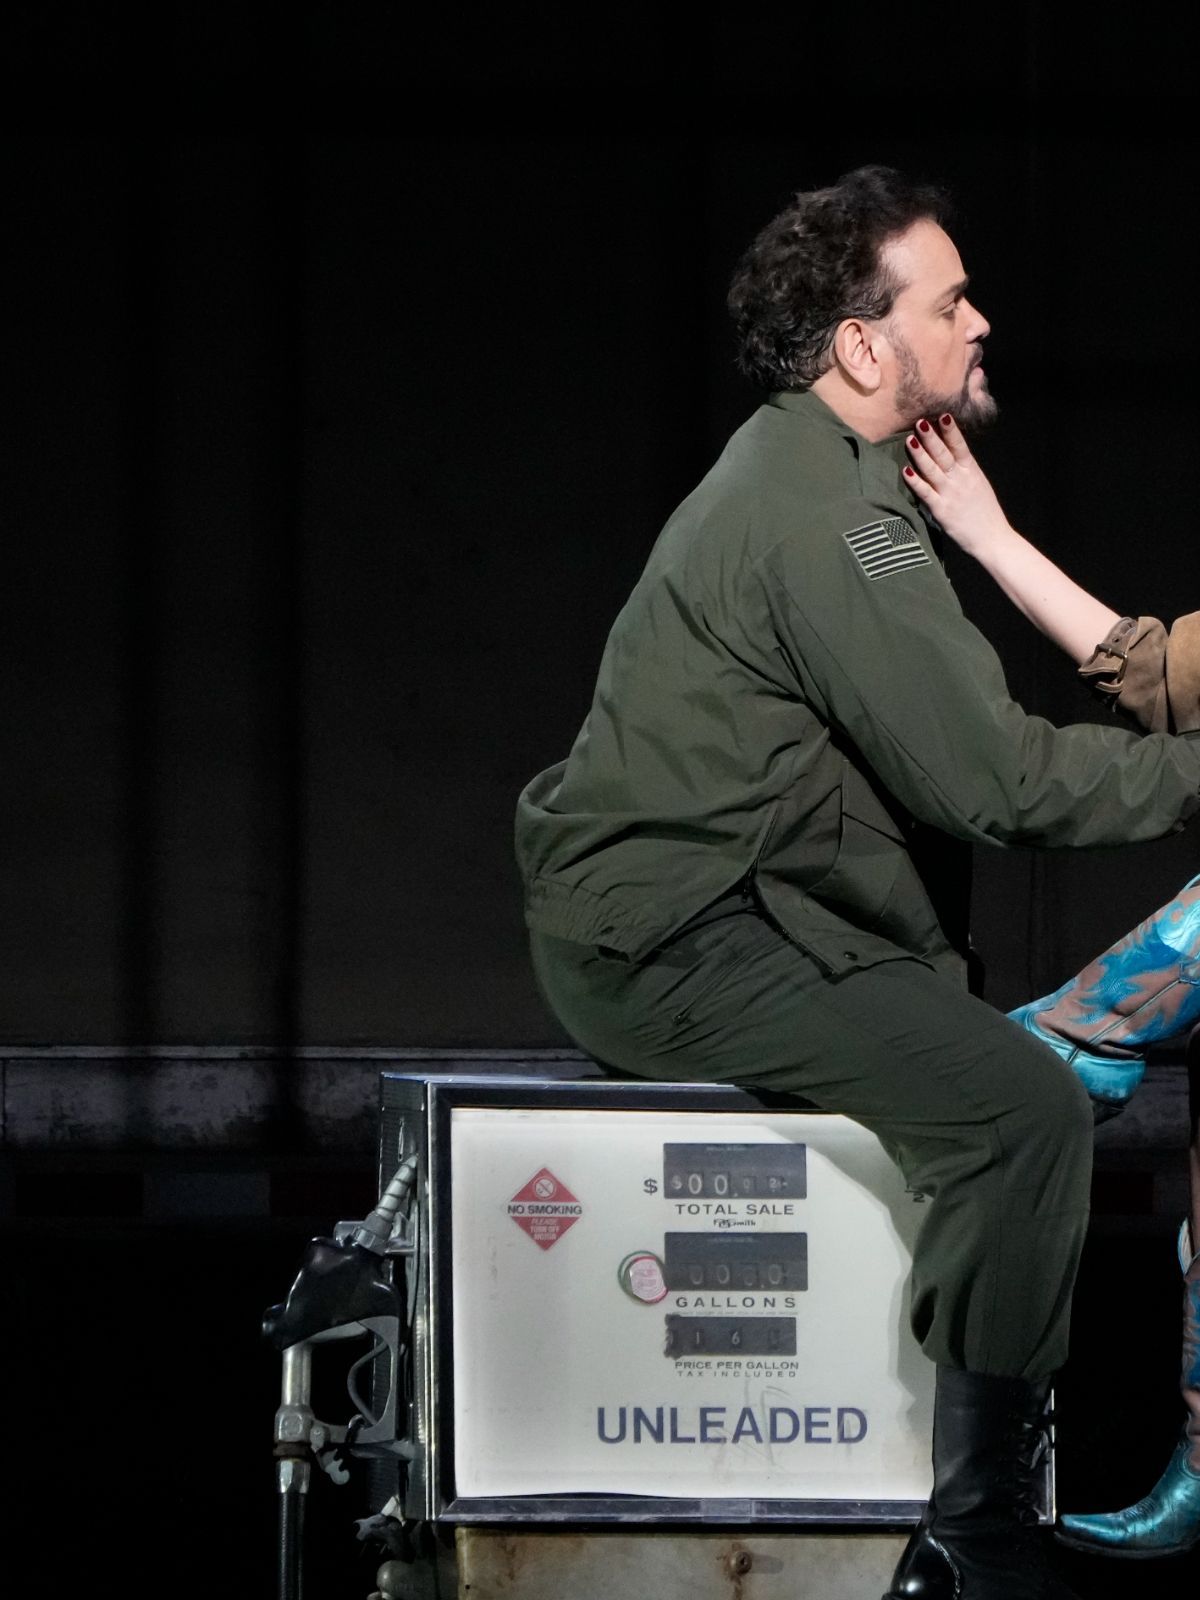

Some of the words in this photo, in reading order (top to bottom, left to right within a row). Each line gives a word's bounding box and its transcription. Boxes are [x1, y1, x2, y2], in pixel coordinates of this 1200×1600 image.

[643, 1178, 659, 1196] $
[507, 1204, 525, 1215] NO
[527, 1204, 583, 1215] SMOKING
[675, 1203, 738, 1216] TOTAL
[746, 1203, 795, 1216] SALE
[675, 1296, 796, 1309] GALLONS
[675, 1361, 713, 1370] PRICE
[716, 1361, 742, 1370] PER
[746, 1361, 799, 1370] GALLON
[678, 1370, 704, 1378] TAX
[713, 1370, 796, 1378] INCLUDED
[597, 1407, 868, 1444] UNLEADED
